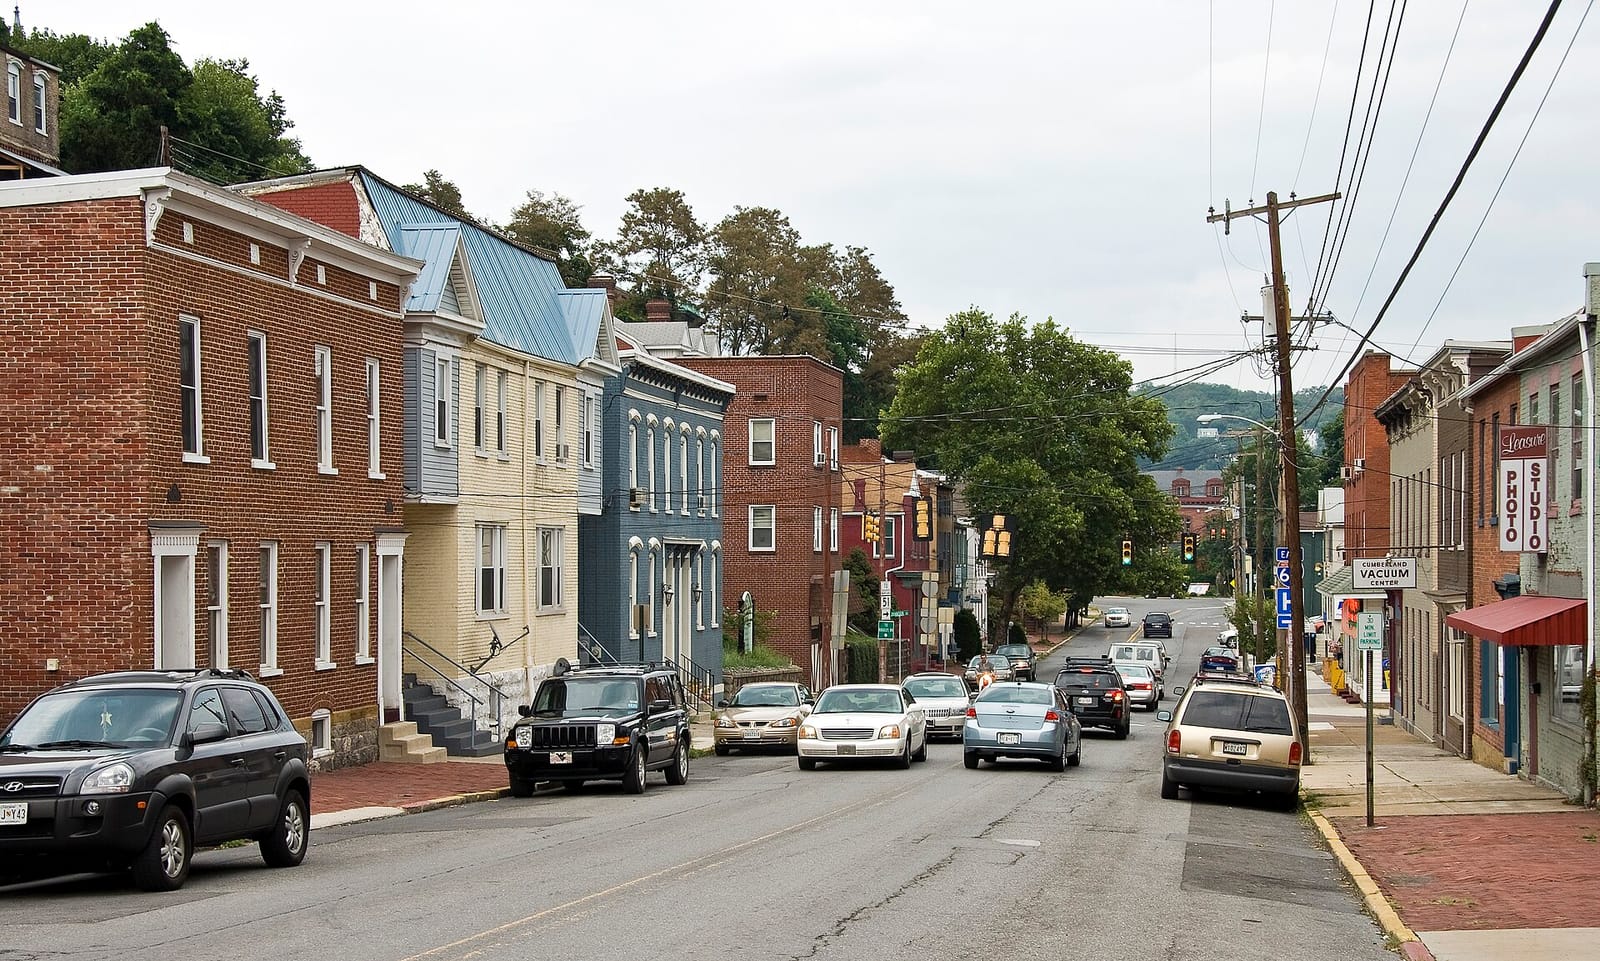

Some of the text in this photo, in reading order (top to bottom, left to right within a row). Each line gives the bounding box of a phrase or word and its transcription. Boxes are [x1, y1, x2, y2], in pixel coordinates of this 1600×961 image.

[1502, 433, 1546, 454] Leasure
[1506, 471, 1518, 542] PHOTO
[1529, 463, 1541, 550] STUDIO
[1360, 569, 1409, 578] VACUUM
[882, 597, 890, 607] 51
